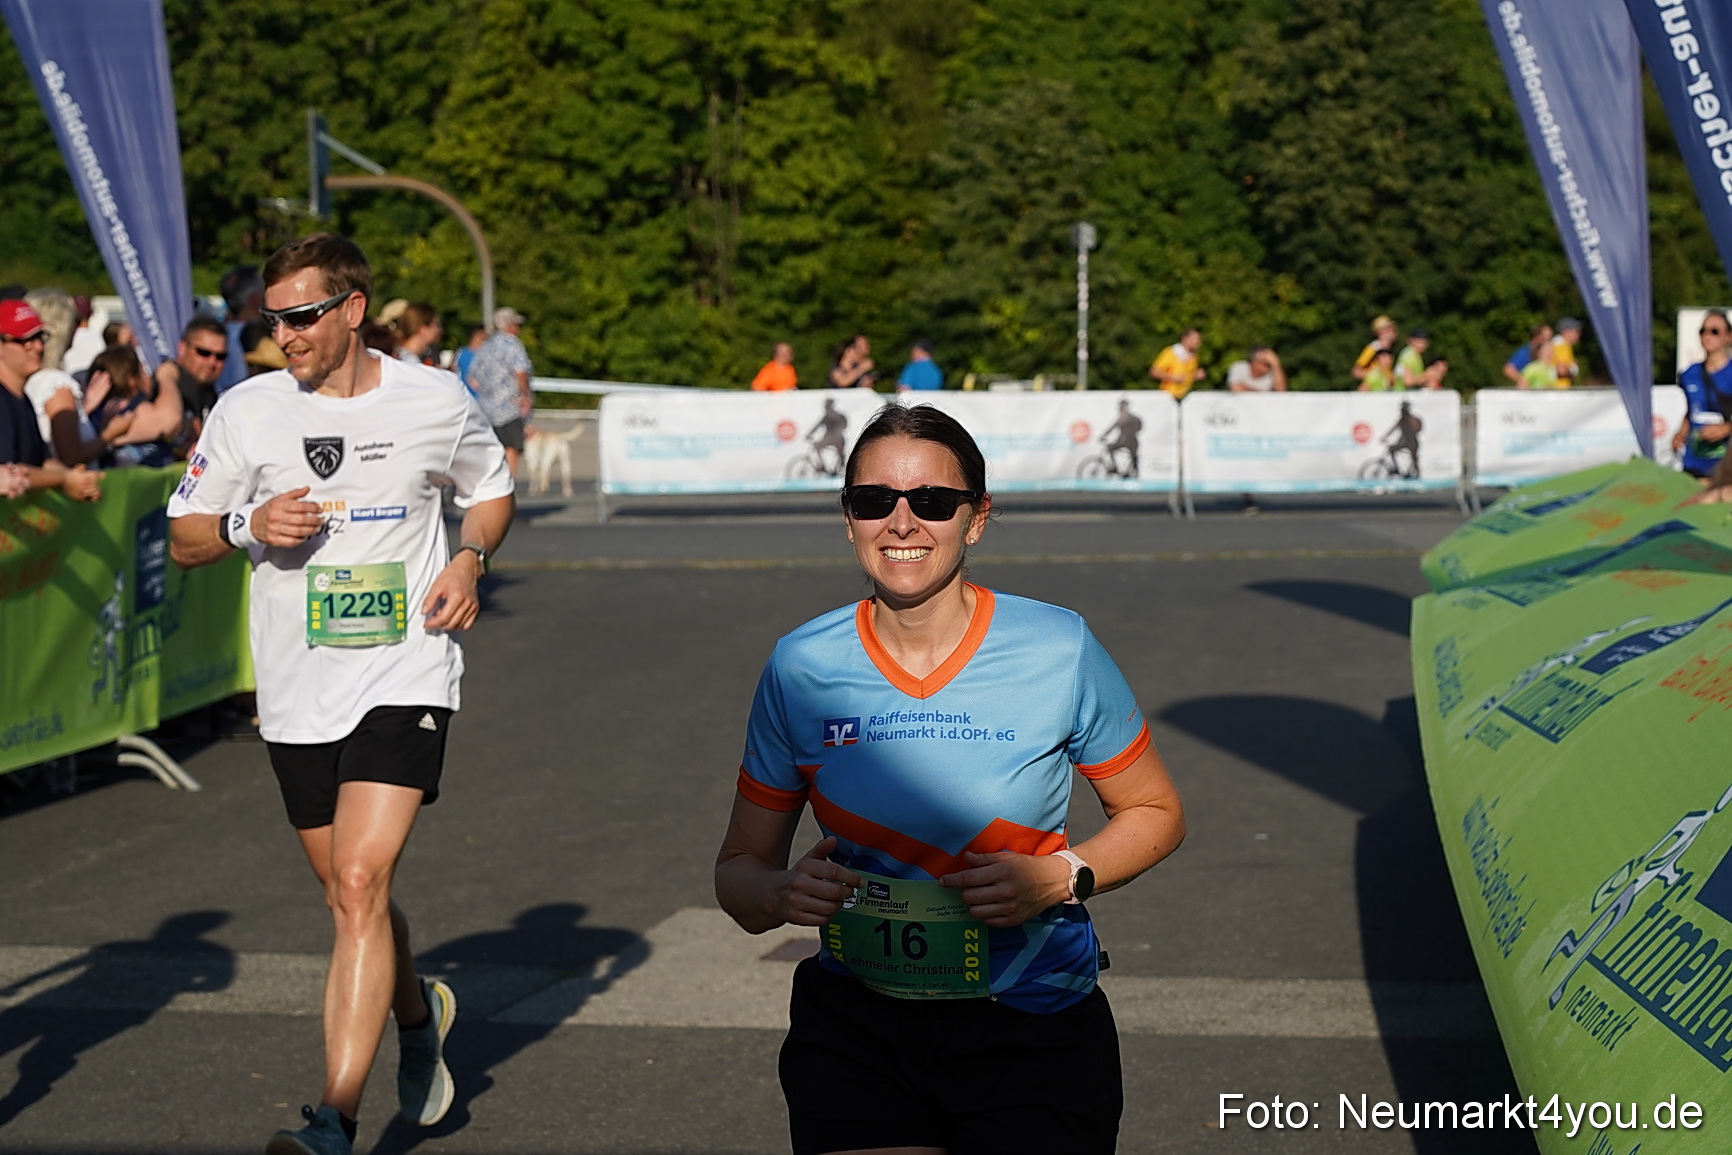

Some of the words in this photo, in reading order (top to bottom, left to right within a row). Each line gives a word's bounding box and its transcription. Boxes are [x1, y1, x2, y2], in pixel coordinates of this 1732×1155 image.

[311, 600, 321, 630] RUN
[323, 590, 393, 619] 1229
[394, 592, 405, 631] 2022
[869, 710, 972, 726] Raiffeisenbank
[866, 726, 936, 742] Neumarkt
[940, 727, 992, 741] i.d.OPf.
[996, 730, 1015, 741] eG
[860, 896, 910, 909] Firmenlauf
[828, 923, 844, 963] RUN
[874, 919, 929, 961] 16
[964, 928, 980, 982] 2022
[845, 955, 900, 973] Lehmeier
[903, 963, 964, 975] Christina
[1564, 984, 1640, 1052] neumarkt
